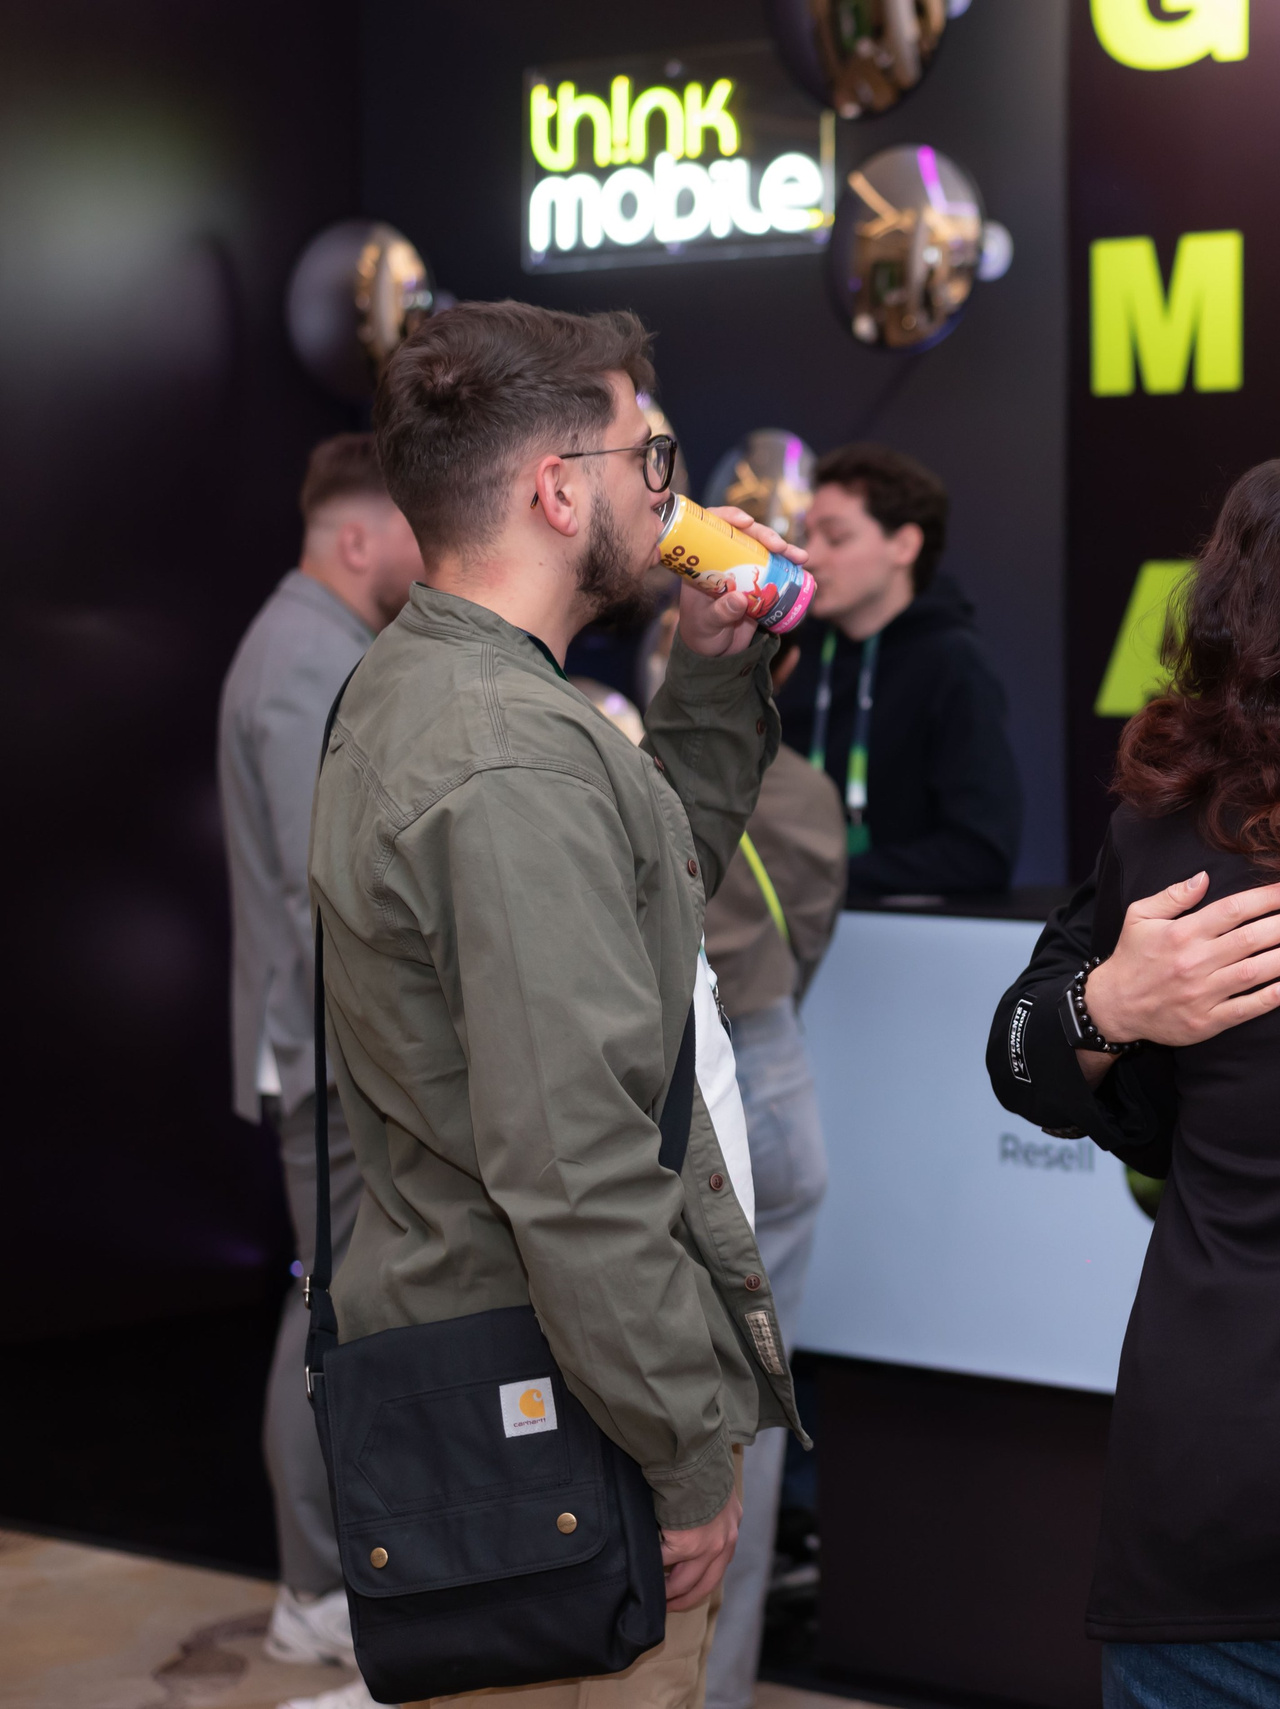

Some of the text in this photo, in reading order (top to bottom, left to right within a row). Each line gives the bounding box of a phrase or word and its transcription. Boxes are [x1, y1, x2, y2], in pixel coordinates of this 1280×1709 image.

[529, 152, 824, 252] mobile
[1010, 1006, 1023, 1072] VETEMENTS
[1015, 1009, 1028, 1055] AVIATION
[999, 1132, 1095, 1173] Resell
